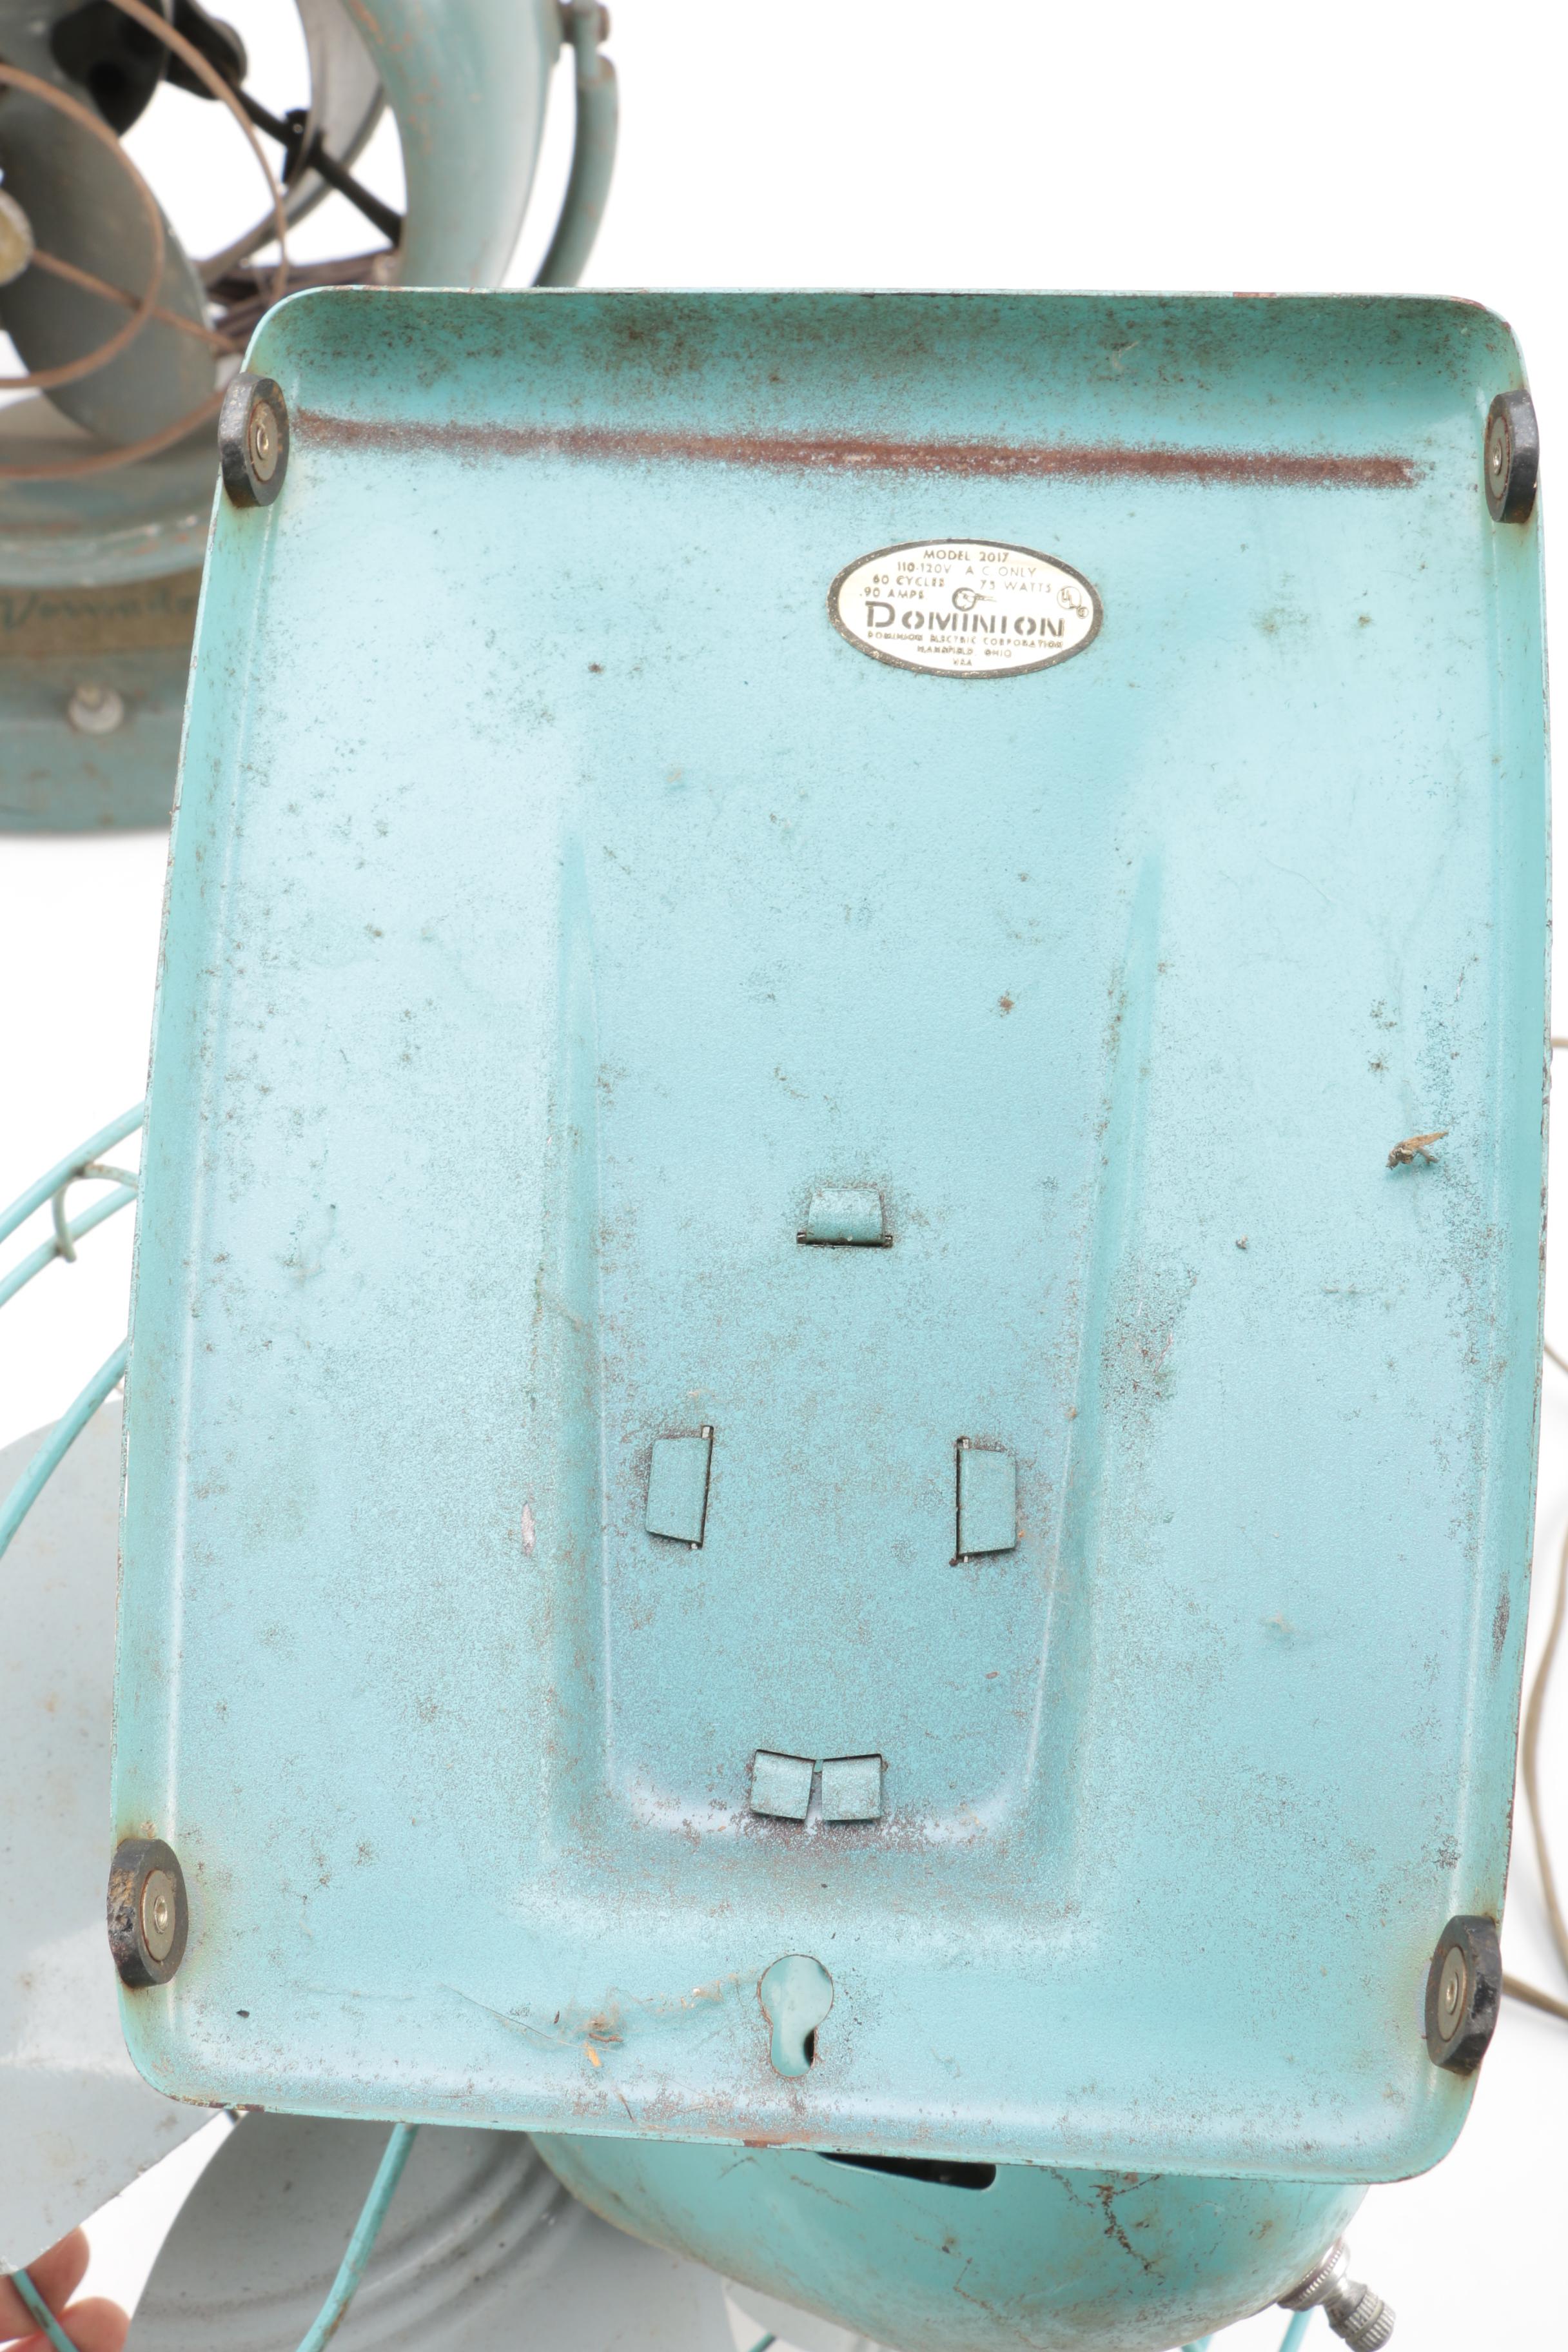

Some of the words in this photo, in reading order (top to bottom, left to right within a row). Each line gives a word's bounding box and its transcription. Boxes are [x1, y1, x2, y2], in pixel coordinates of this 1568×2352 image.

[923, 550, 970, 561] MODEL
[979, 551, 1009, 562] 2017
[897, 562, 952, 574] 110-120V
[998, 567, 1037, 578] ONLY
[873, 574, 889, 585] 60
[897, 575, 945, 587] CYCLES
[980, 580, 995, 591] 75
[1004, 581, 1052, 593] WATTS
[865, 601, 1064, 636] DOMINION
[868, 631, 923, 642] DOMINION
[983, 638, 1063, 649] CORPORATION
[985, 649, 1012, 658] OHIO
